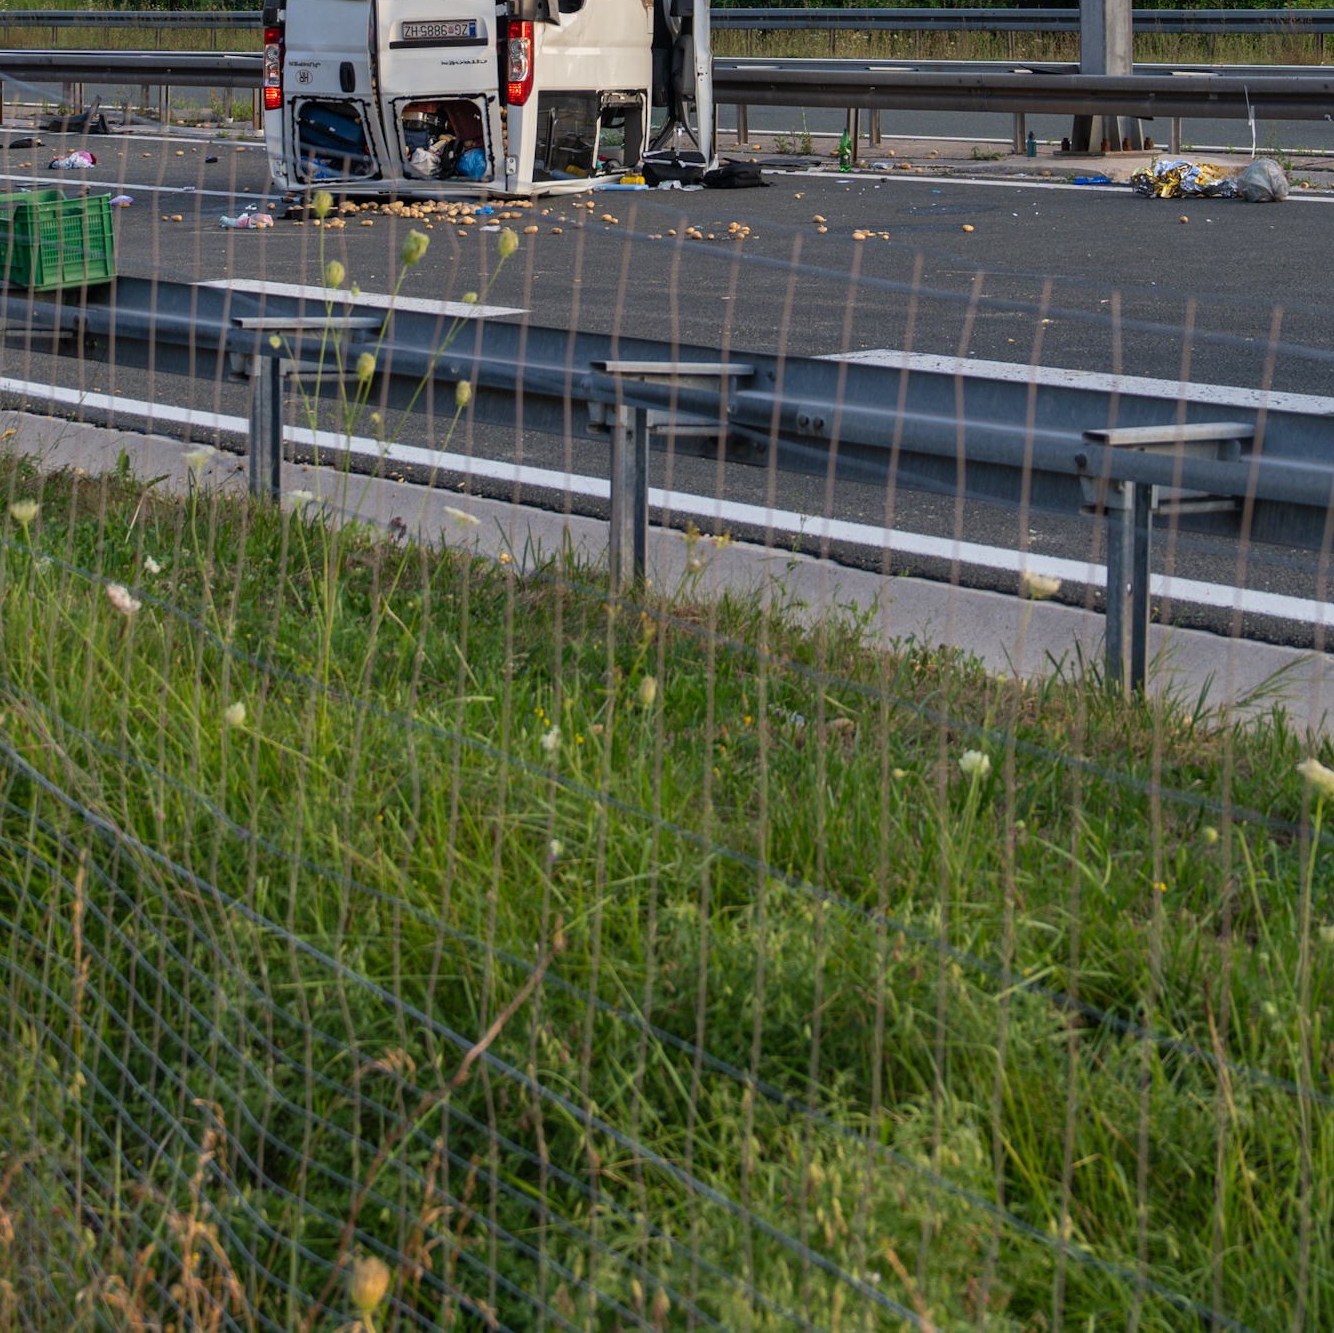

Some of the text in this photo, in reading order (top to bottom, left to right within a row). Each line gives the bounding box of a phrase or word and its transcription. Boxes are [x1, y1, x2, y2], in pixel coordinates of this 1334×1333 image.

[404, 24, 468, 37] ZG 9885-HZ
[299, 71, 309, 83] HR
